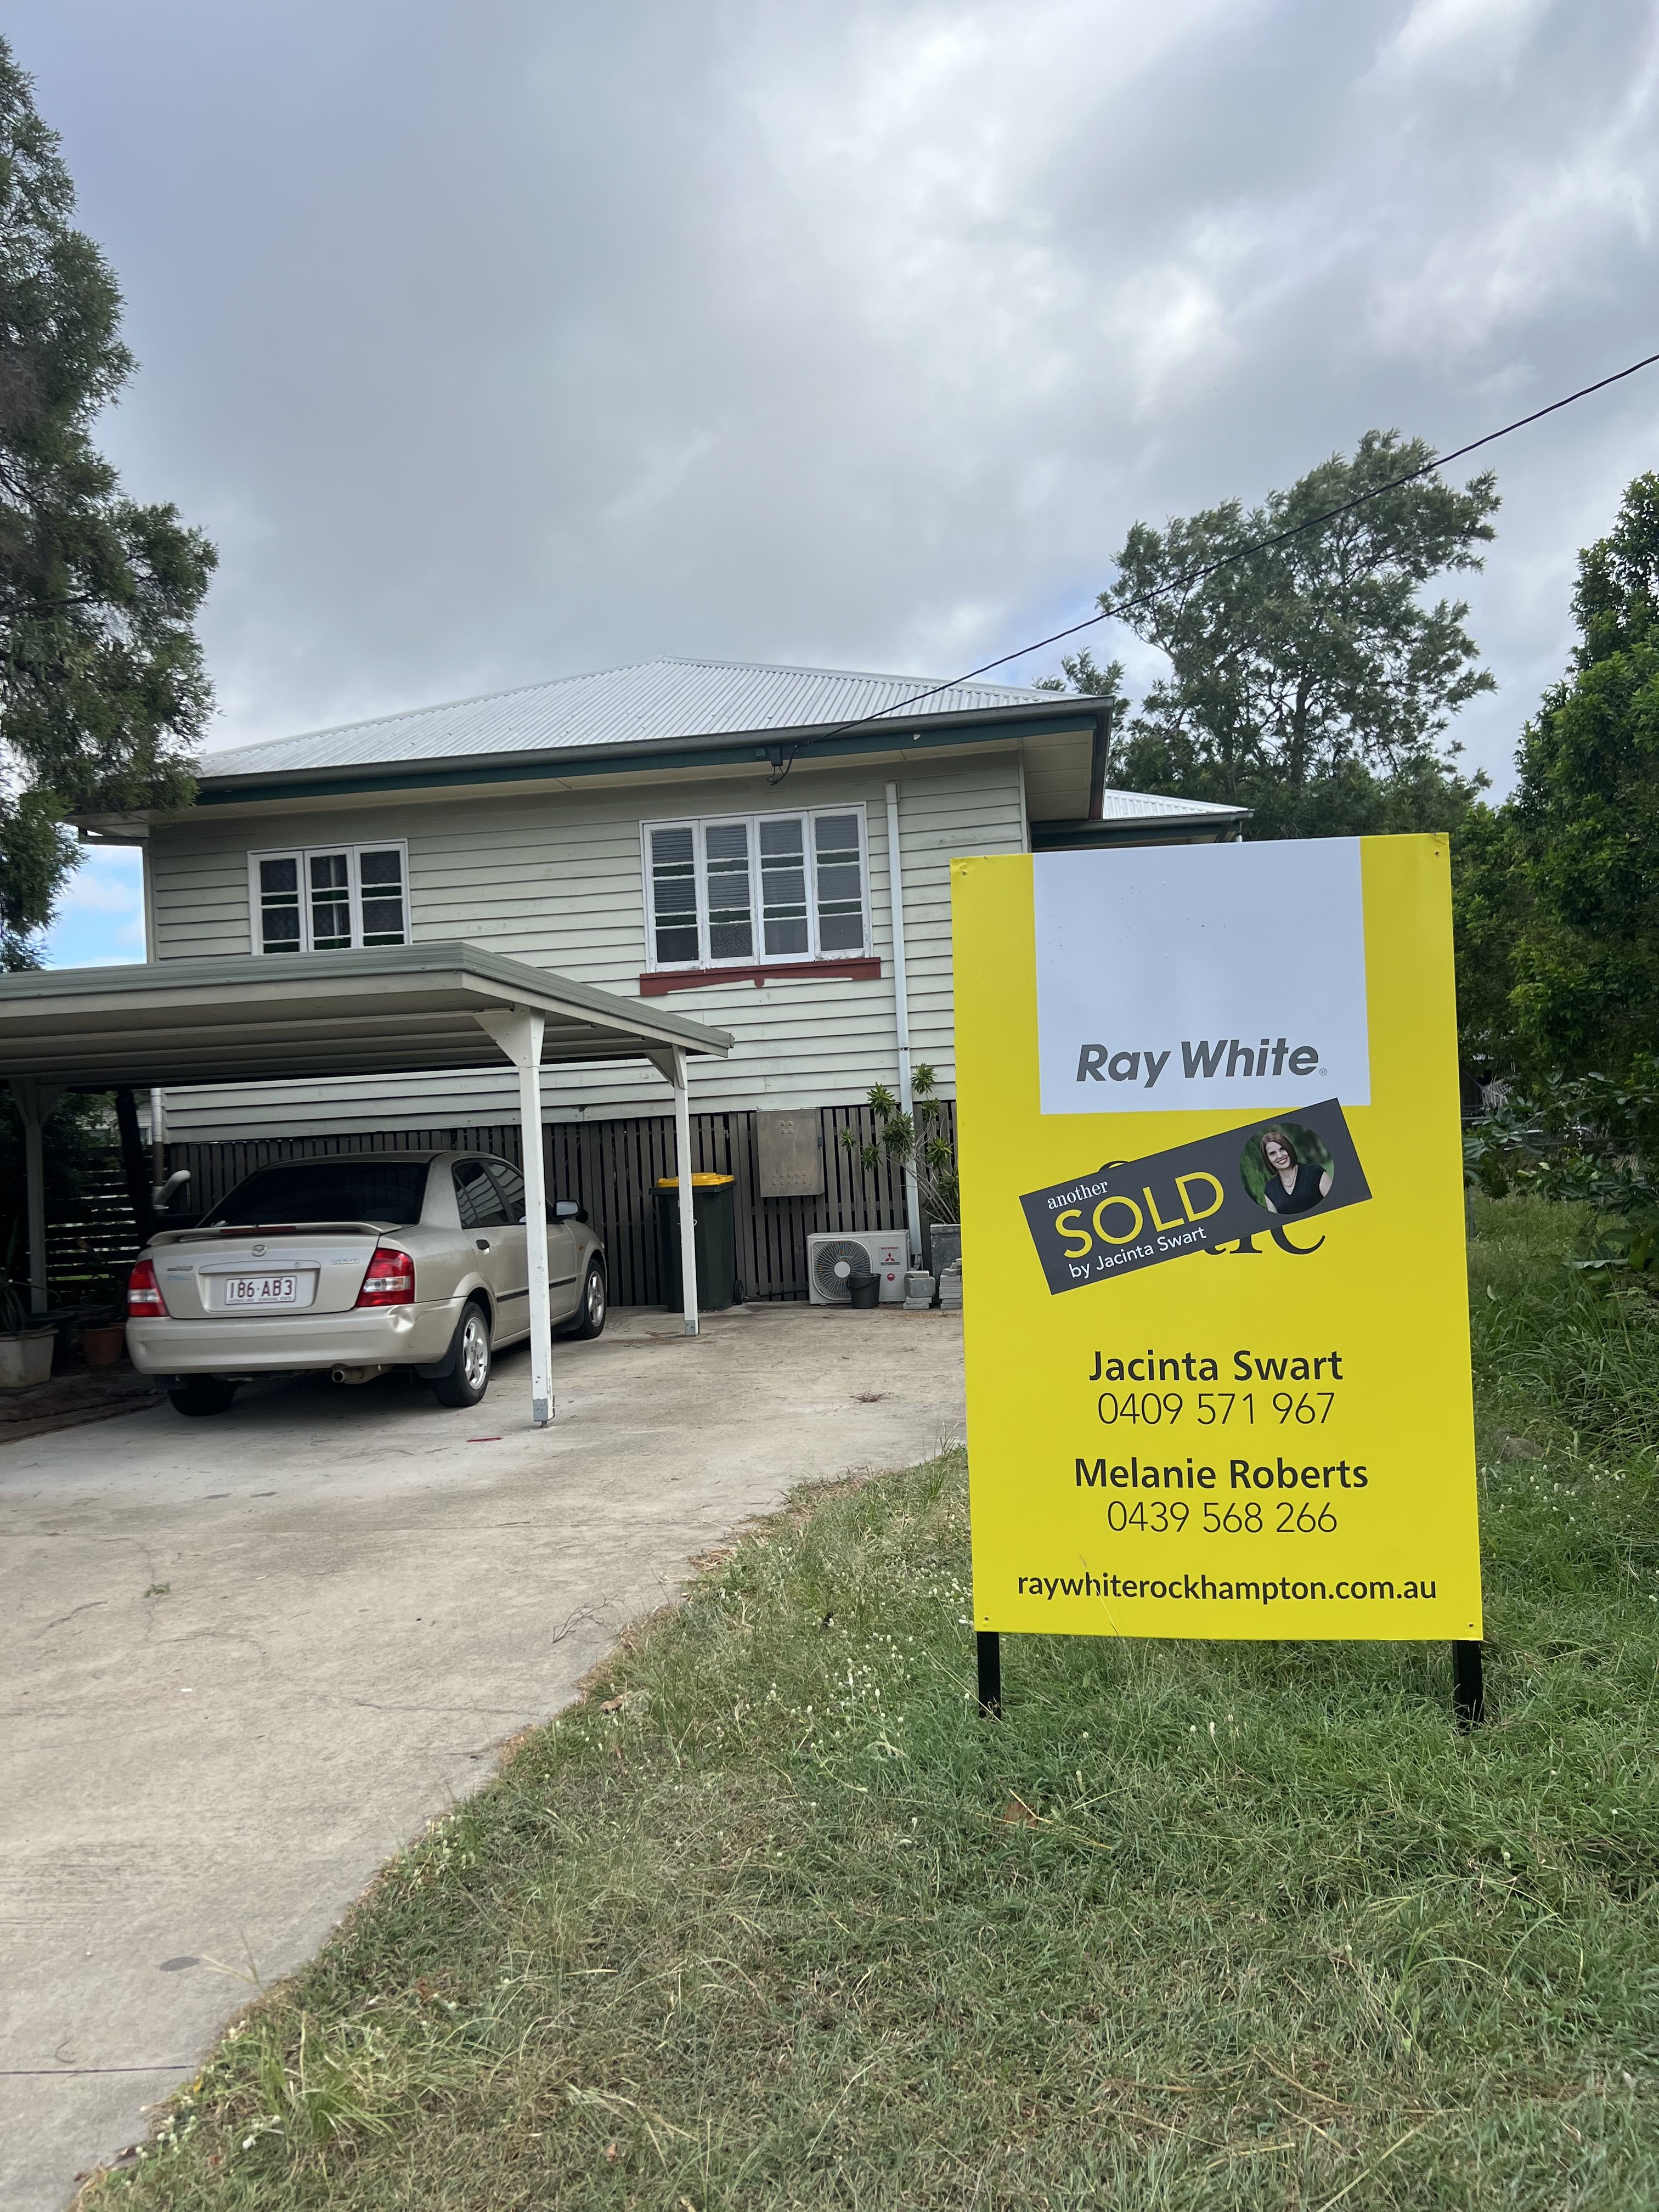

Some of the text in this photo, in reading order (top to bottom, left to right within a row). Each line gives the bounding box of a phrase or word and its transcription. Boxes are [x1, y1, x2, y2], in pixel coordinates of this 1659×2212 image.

[1076, 1043, 1172, 1088] Ray
[1047, 1181, 1108, 1210] another
[1054, 1171, 1224, 1259] SOLD
[1068, 1227, 1207, 1279] by Jacinta Swart
[1089, 1349, 1343, 1381] Jacinta Swart
[1098, 1392, 1335, 1425] 0409 571 967
[1075, 1457, 1368, 1489] Melanie Roberts
[1108, 1500, 1338, 1533] 0439 568 266
[1018, 1572, 1437, 1605] raywhiterockhampton.com.au
